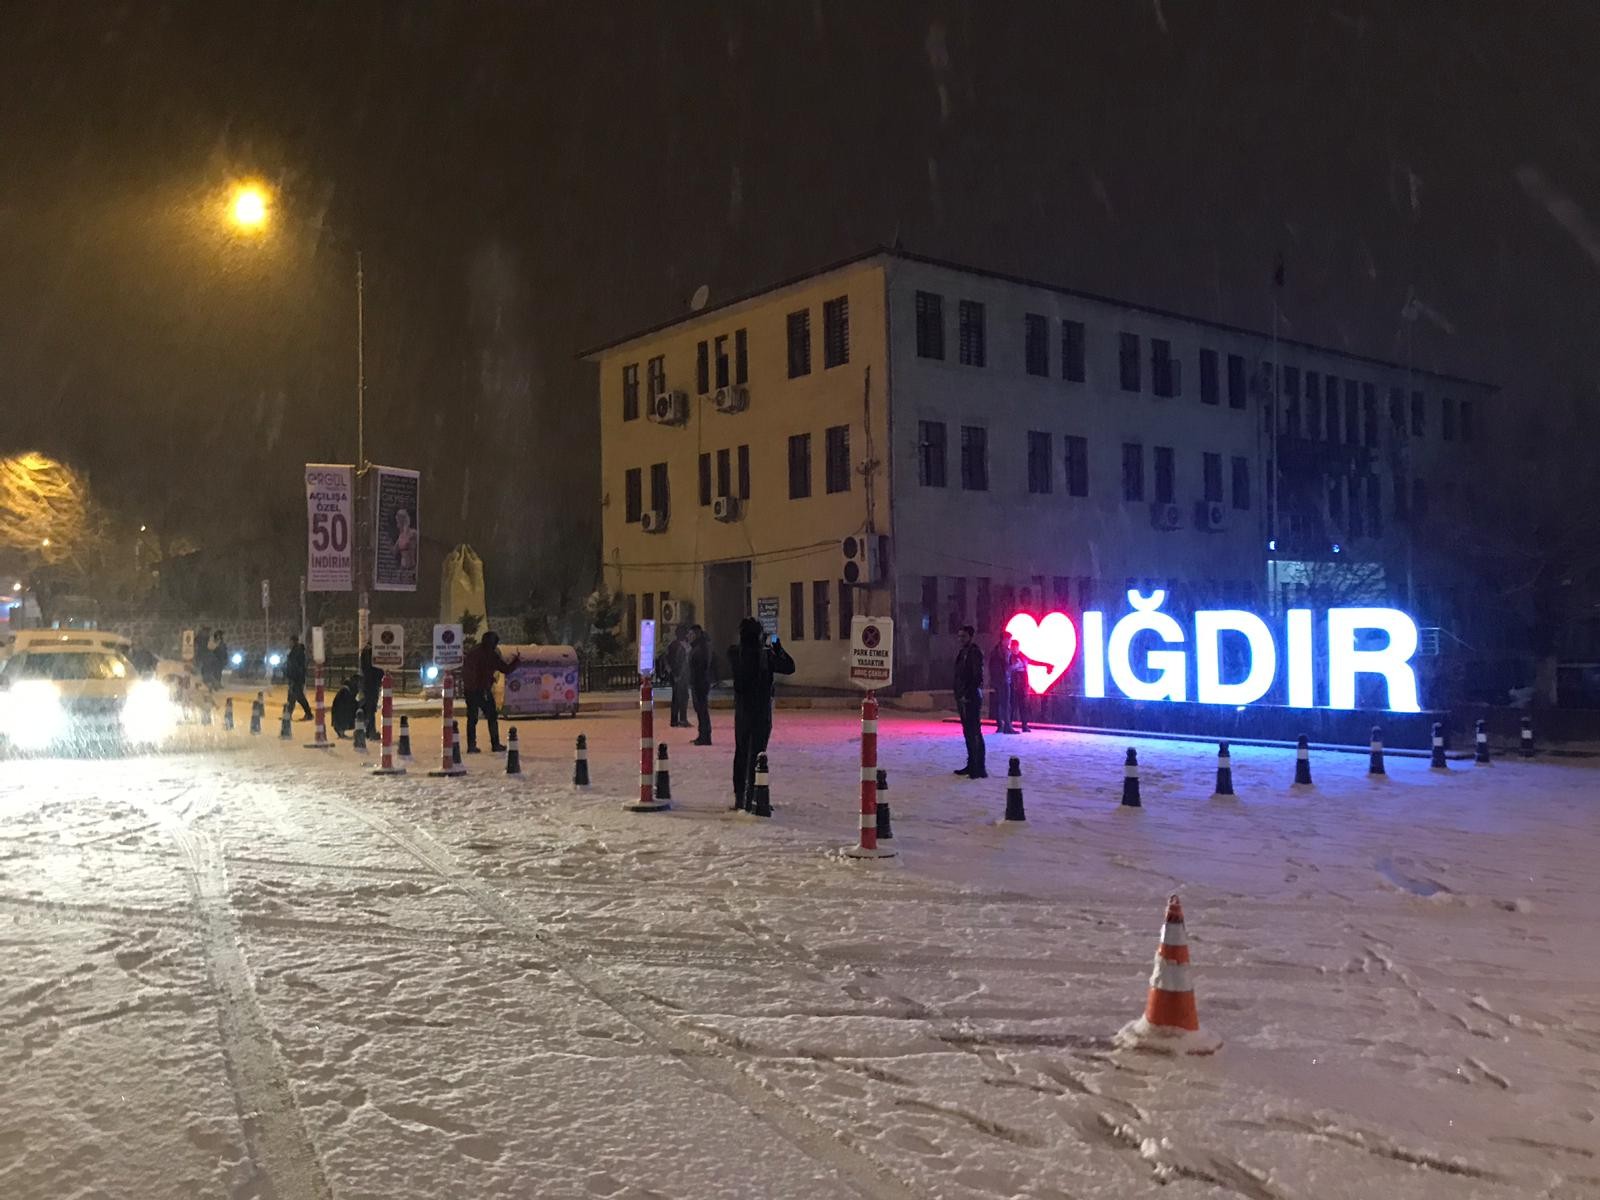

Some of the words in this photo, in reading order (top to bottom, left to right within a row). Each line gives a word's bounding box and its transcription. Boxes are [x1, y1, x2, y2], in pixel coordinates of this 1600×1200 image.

[309, 492, 347, 502] AÇILIŞA
[316, 502, 341, 512] ÖZEL
[312, 513, 348, 552] 50
[311, 553, 350, 568] İNDİRİM
[1082, 589, 1421, 712] IĞDIR
